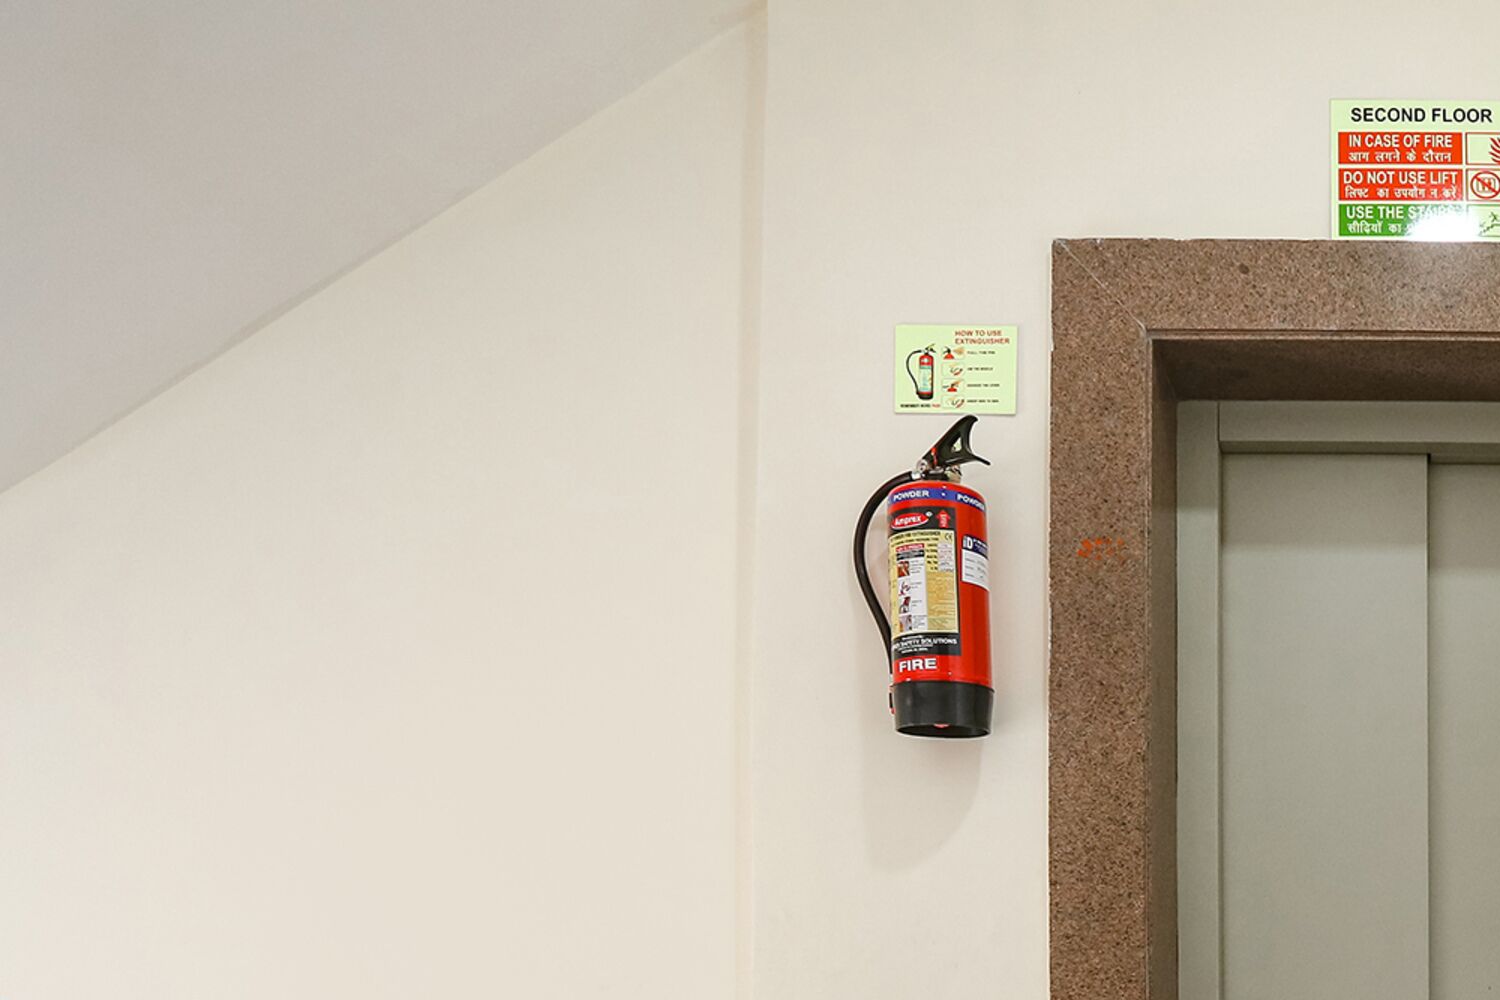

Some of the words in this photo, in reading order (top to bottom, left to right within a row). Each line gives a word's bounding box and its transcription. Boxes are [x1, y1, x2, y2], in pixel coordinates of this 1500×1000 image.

[1350, 107, 1426, 122] SECOND
[1432, 108, 1492, 123] FLOOR
[1348, 134, 1361, 147] IN
[1365, 134, 1400, 147] CASE
[1403, 134, 1420, 147] OF
[1424, 134, 1453, 148] FIRE
[1343, 171, 1363, 184] DO
[1367, 171, 1395, 184] NOT
[1399, 171, 1426, 184] USE
[1430, 171, 1458, 185] LIFT
[1346, 205, 1374, 219] USE
[1377, 205, 1404, 219] THE
[954, 329, 973, 337] HOW
[975, 329, 985, 337] TO
[893, 489, 930, 501] POWDER
[898, 656, 938, 673] FIRE
